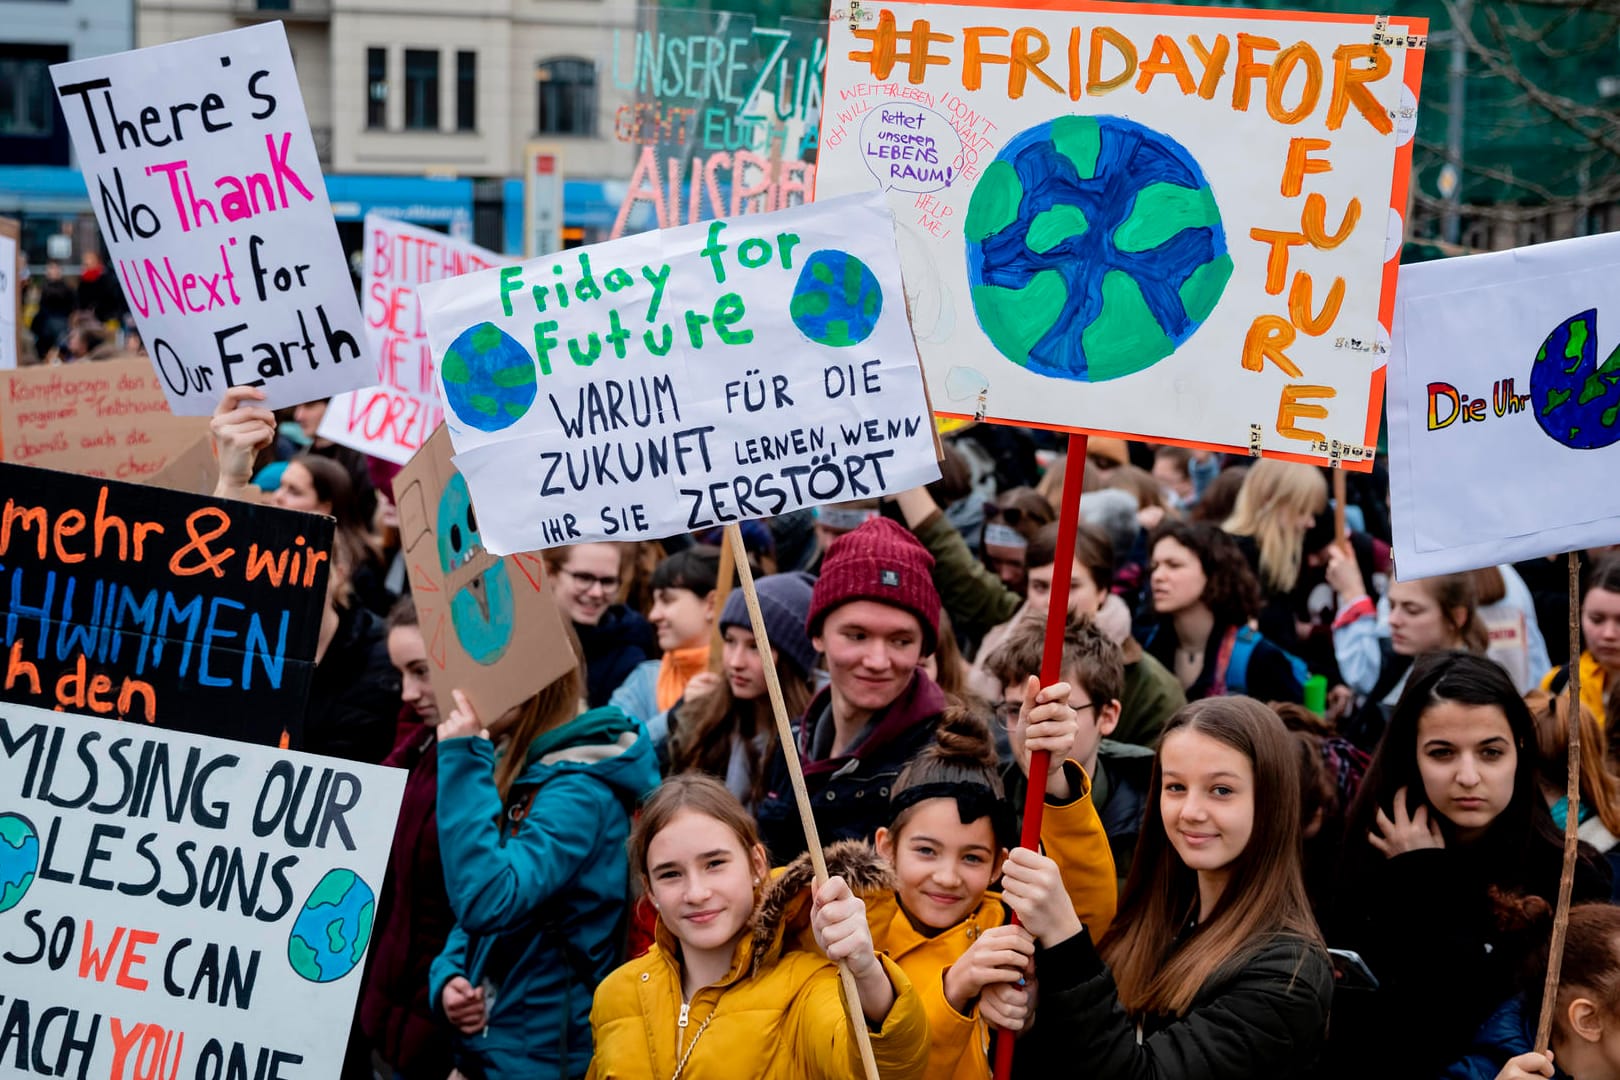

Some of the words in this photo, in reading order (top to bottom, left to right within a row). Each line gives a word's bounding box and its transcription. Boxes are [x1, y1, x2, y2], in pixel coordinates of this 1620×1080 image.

[613, 28, 749, 104] UNSERE
[840, 83, 935, 108] WEITERLEBEN
[58, 56, 277, 154] There's
[614, 101, 696, 145] GEHT
[703, 108, 788, 154] EUCH
[826, 125, 847, 150] ICH
[837, 100, 873, 124] WILL
[878, 131, 935, 148] unseren
[881, 110, 926, 130] Rettet
[948, 96, 997, 135] DON'T
[949, 114, 994, 151] WANT
[867, 142, 939, 164] LEBENS
[891, 164, 952, 188] RAUM!
[960, 140, 978, 165] TO
[97, 167, 161, 243] No
[914, 192, 953, 218] HELP
[249, 234, 310, 301] for
[500, 252, 670, 323] Friday
[701, 221, 801, 284] for
[154, 338, 213, 396] Our
[214, 305, 361, 387] Earth
[533, 292, 754, 376] Future
[549, 373, 680, 439] WARUM
[725, 369, 794, 414] FÜR
[824, 359, 883, 399] DIE
[1427, 382, 1486, 431] Die
[1493, 378, 1531, 418] Uhr
[540, 425, 715, 497] ZUKUNFT
[735, 427, 838, 466] LERNEN,
[841, 415, 922, 448] WENN
[541, 513, 581, 544] IHR
[603, 504, 649, 536] SIE
[680, 449, 895, 531] ZERSTÖRT
[0, 486, 164, 563] mehr
[169, 507, 235, 578] &
[245, 535, 328, 588] wir
[0, 562, 290, 690] HWIMMEN
[0, 718, 240, 829] MISSING
[252, 760, 362, 851] OUR
[38, 816, 299, 922] LESSONS
[3, 910, 76, 971] SO
[78, 919, 160, 991] WE
[163, 938, 261, 1010] CAN
[0, 995, 101, 1080] ACH
[110, 1017, 184, 1080] YOU
